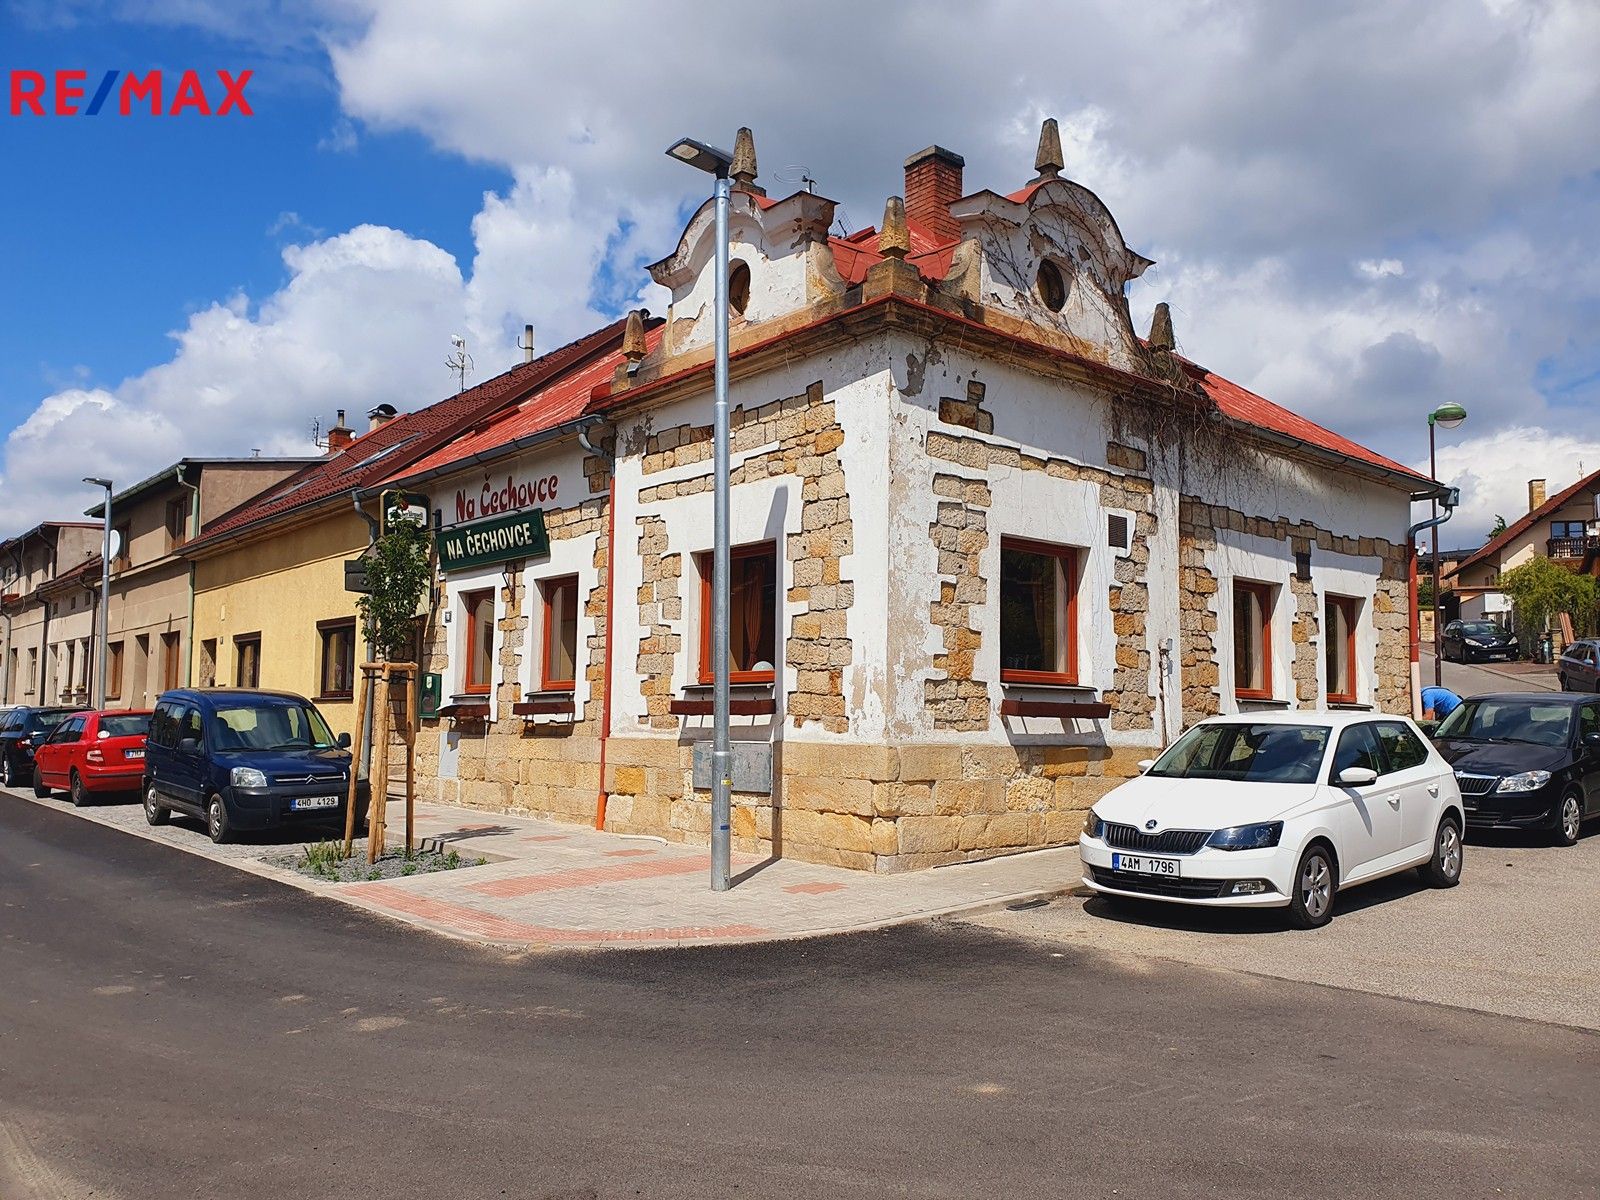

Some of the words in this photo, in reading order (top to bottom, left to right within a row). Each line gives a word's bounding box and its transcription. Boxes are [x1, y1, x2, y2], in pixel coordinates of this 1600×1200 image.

[456, 489, 475, 523] Na
[480, 473, 558, 516] Čechovce
[446, 539, 465, 560] NA
[465, 523, 532, 557] ČECHOVCE
[316, 797, 336, 806] 4129
[1121, 856, 1140, 870] 4AM
[1148, 859, 1174, 874] 1796
